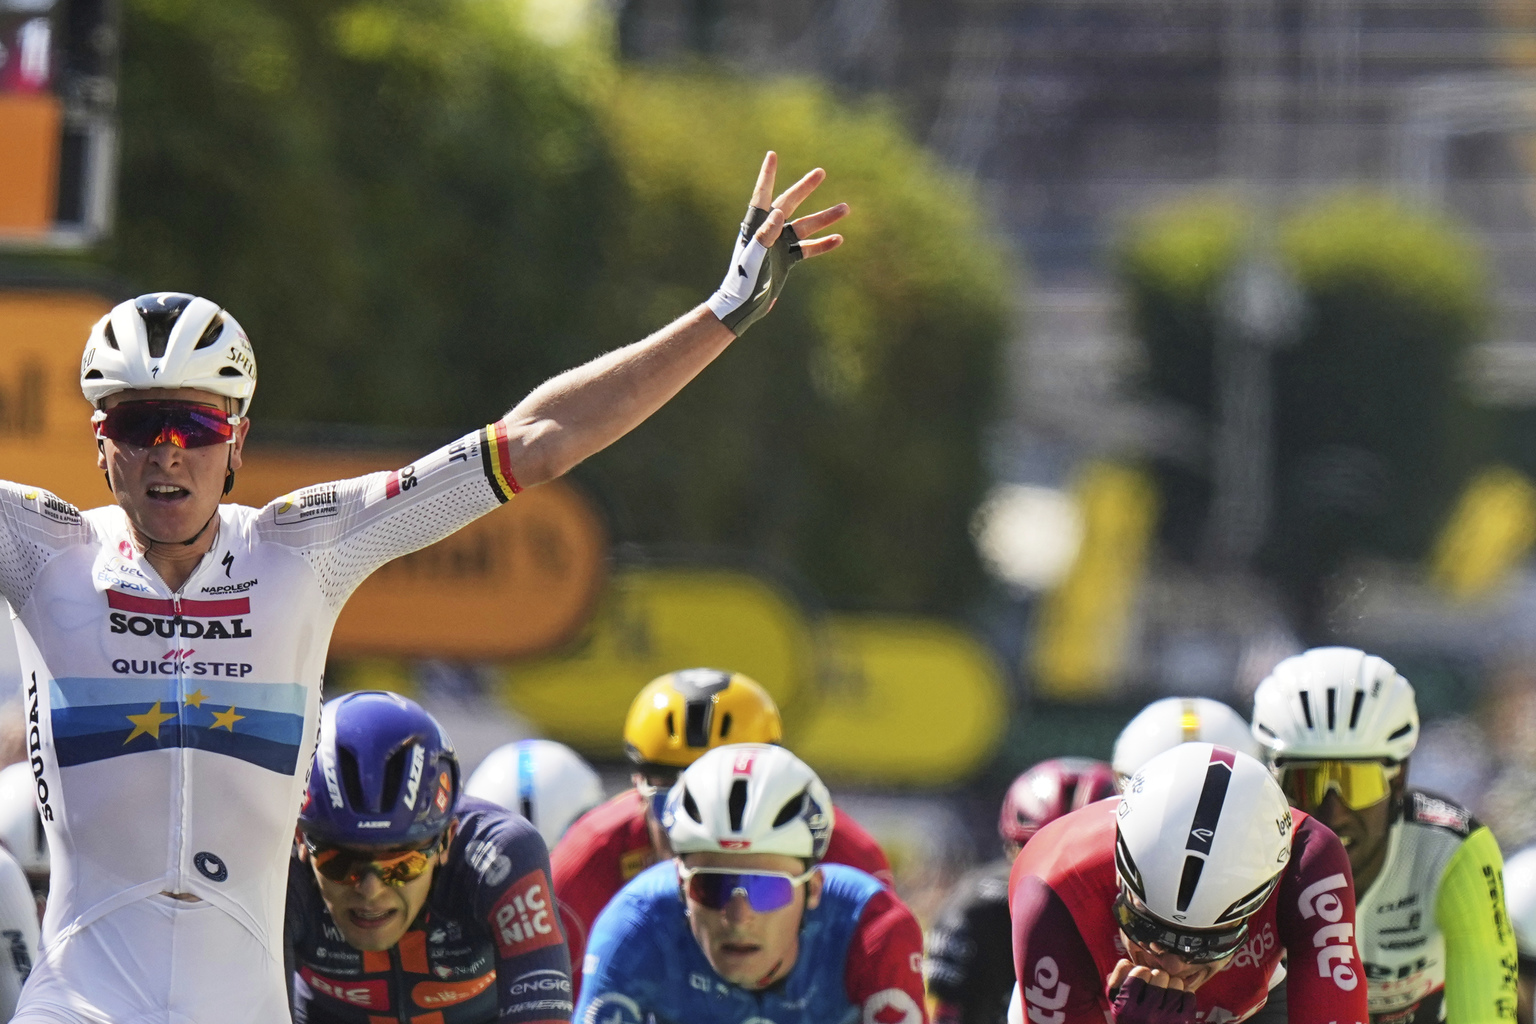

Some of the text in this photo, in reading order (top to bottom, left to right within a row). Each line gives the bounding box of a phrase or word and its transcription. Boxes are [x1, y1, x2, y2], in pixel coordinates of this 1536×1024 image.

[201, 579, 258, 594] NAPOLEON
[110, 613, 252, 639] SOUDAL
[28, 671, 54, 822] SOUDAL
[1220, 922, 1275, 971] aps
[1297, 873, 1358, 991] Lotto
